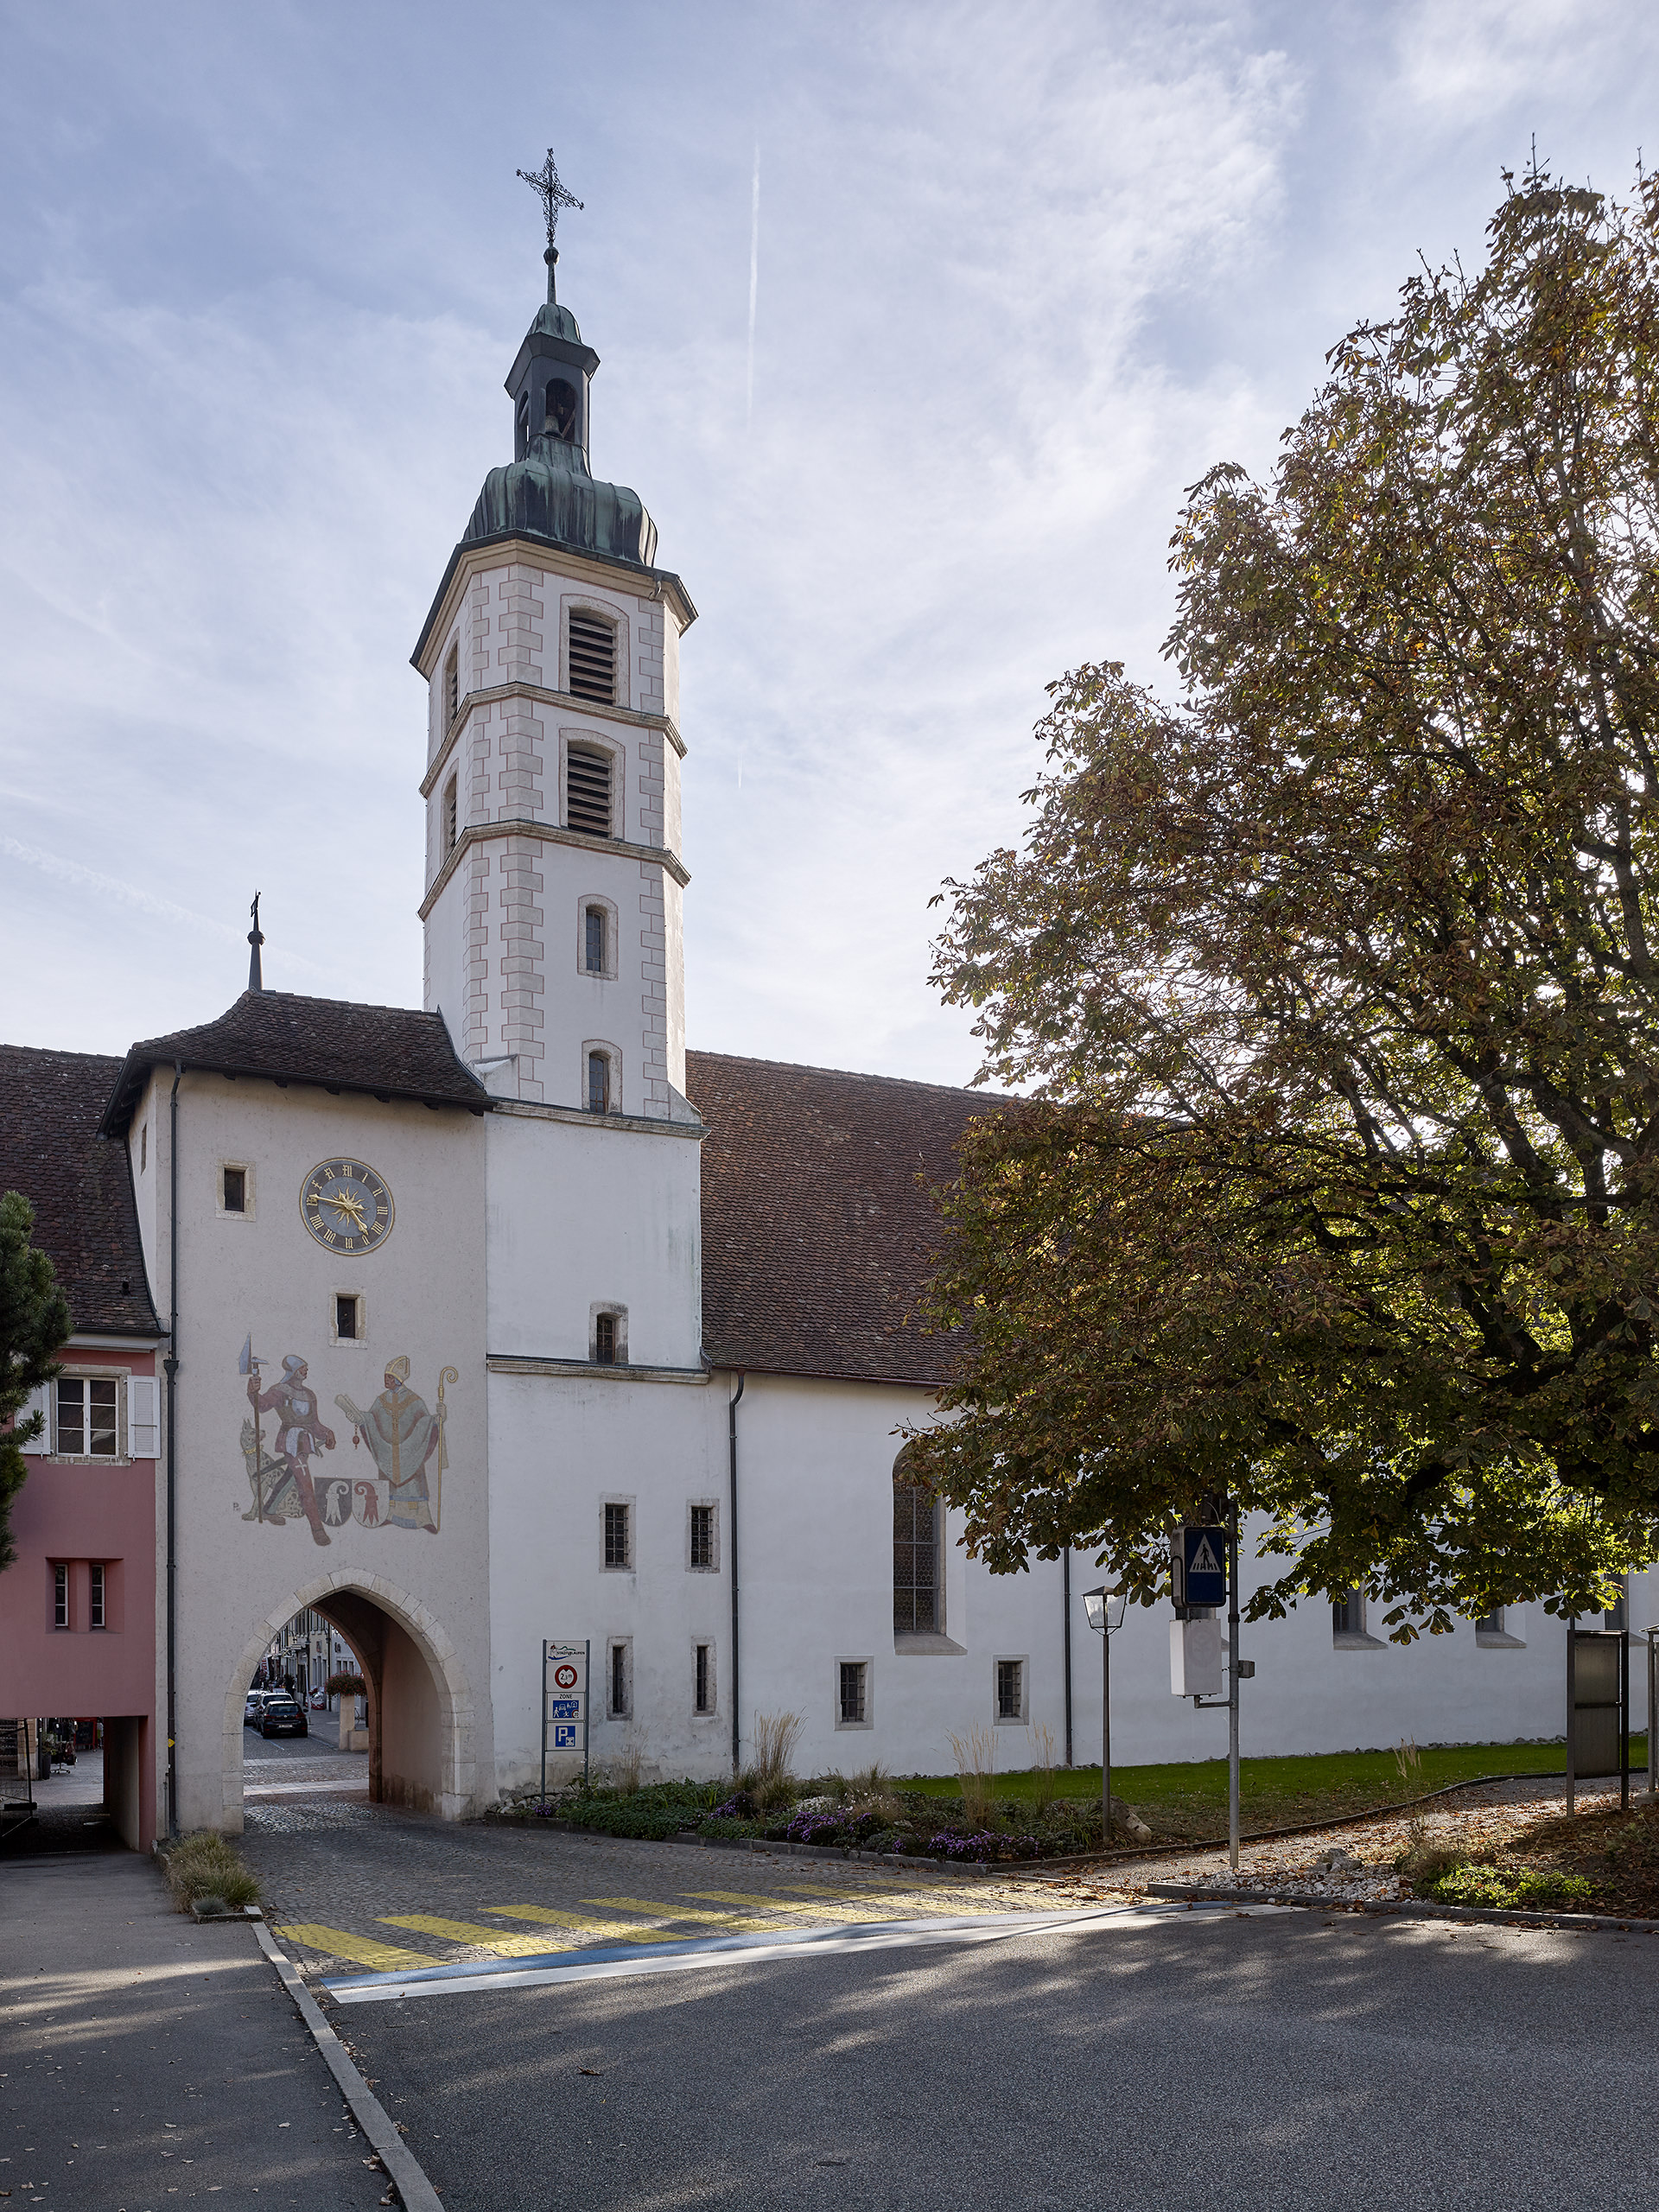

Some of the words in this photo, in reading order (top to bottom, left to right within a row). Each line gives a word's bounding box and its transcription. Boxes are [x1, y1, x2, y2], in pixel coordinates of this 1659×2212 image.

[324, 1167, 335, 1180] XI
[341, 1165, 353, 1177] XII
[362, 1173, 368, 1183] I
[372, 1187, 383, 1197] II
[377, 1206, 388, 1215] III
[558, 1727, 568, 1742] P
